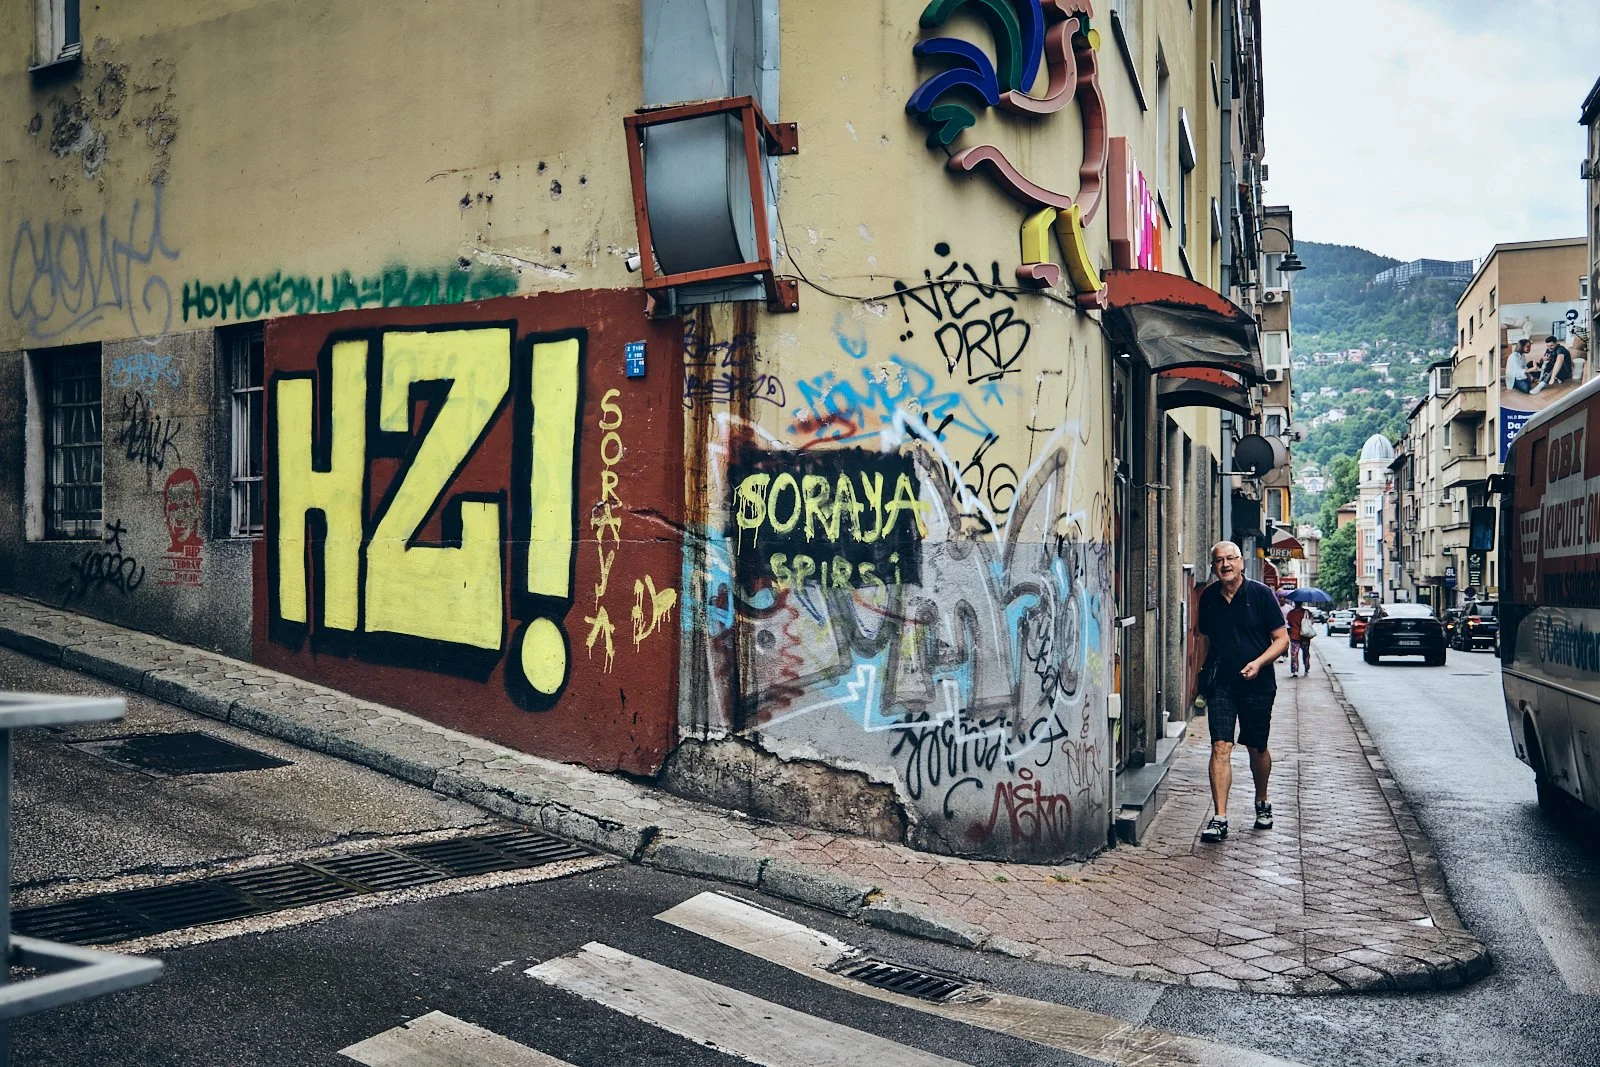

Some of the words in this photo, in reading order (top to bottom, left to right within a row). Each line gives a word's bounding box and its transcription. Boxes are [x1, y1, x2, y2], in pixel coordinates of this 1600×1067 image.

[268, 321, 587, 710] HZ!
[584, 388, 623, 672] SORAYA
[734, 470, 931, 552] SORAYA
[1549, 427, 1584, 484] OBI
